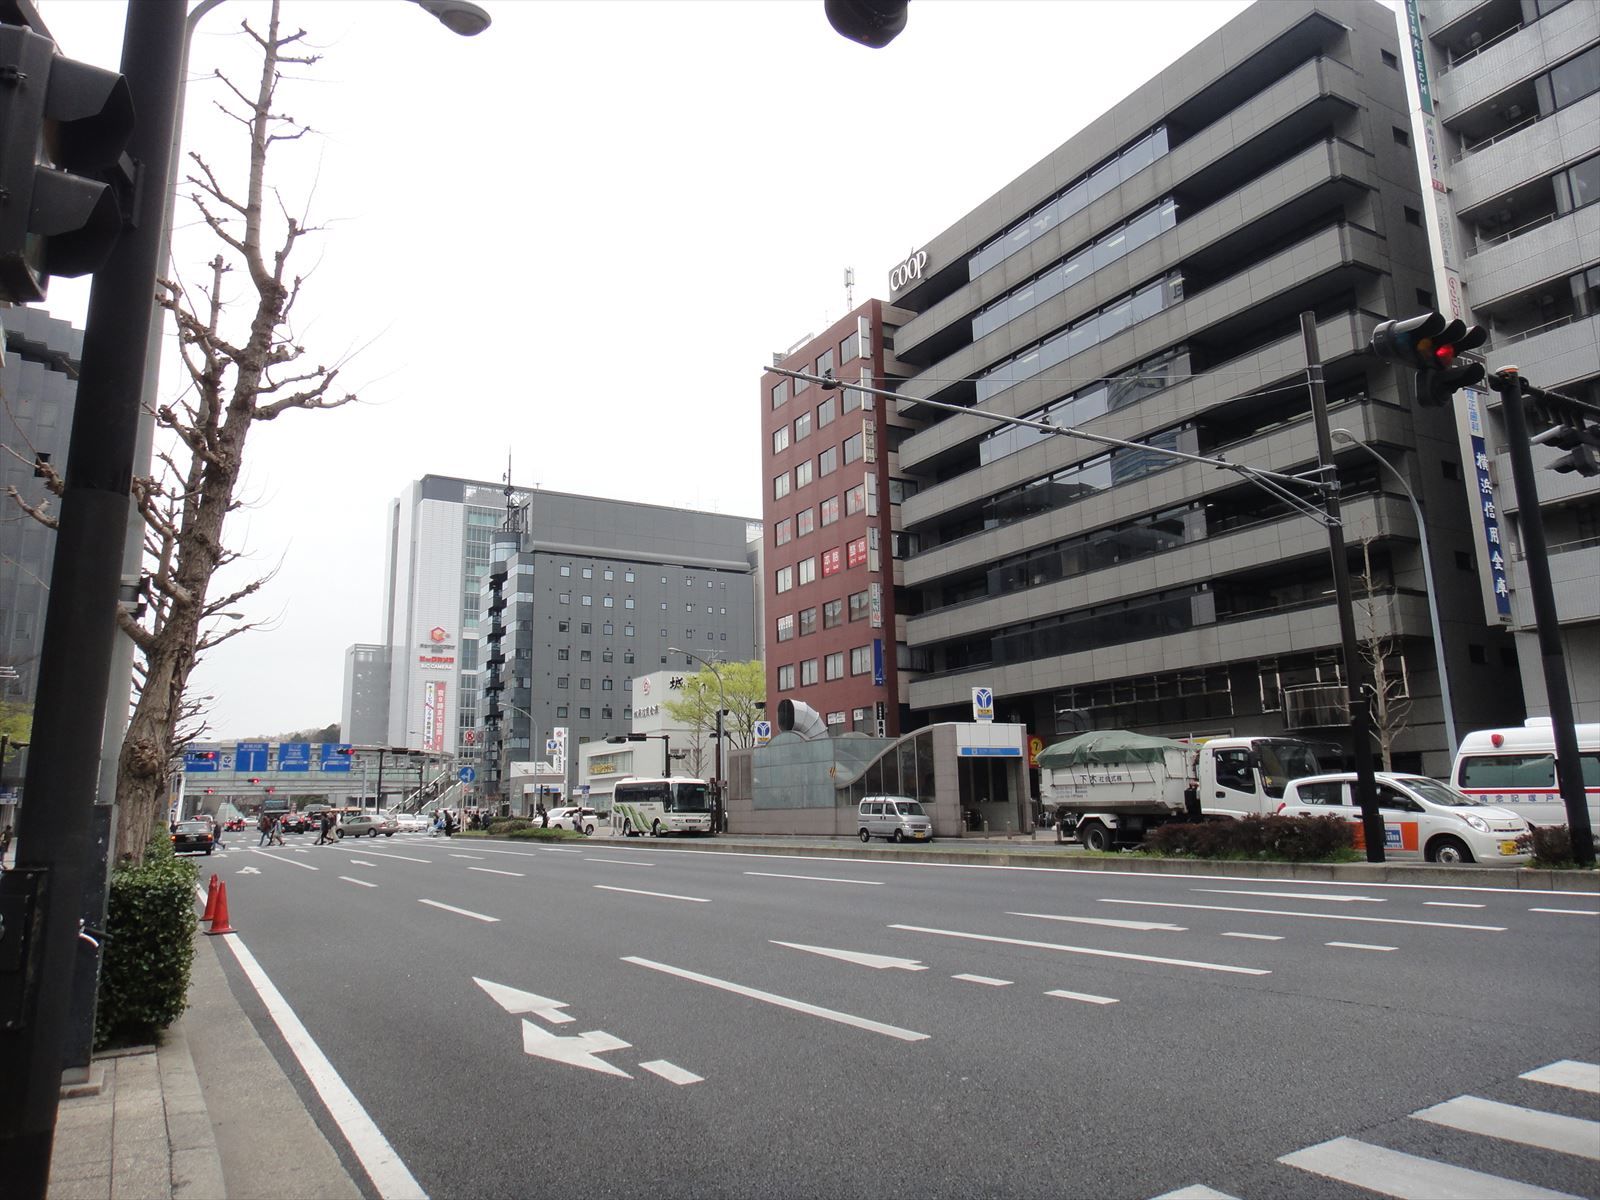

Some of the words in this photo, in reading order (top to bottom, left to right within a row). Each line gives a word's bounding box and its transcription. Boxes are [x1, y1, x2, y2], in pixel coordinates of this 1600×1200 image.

[1475, 452, 1508, 598] 横浜信用金庫
